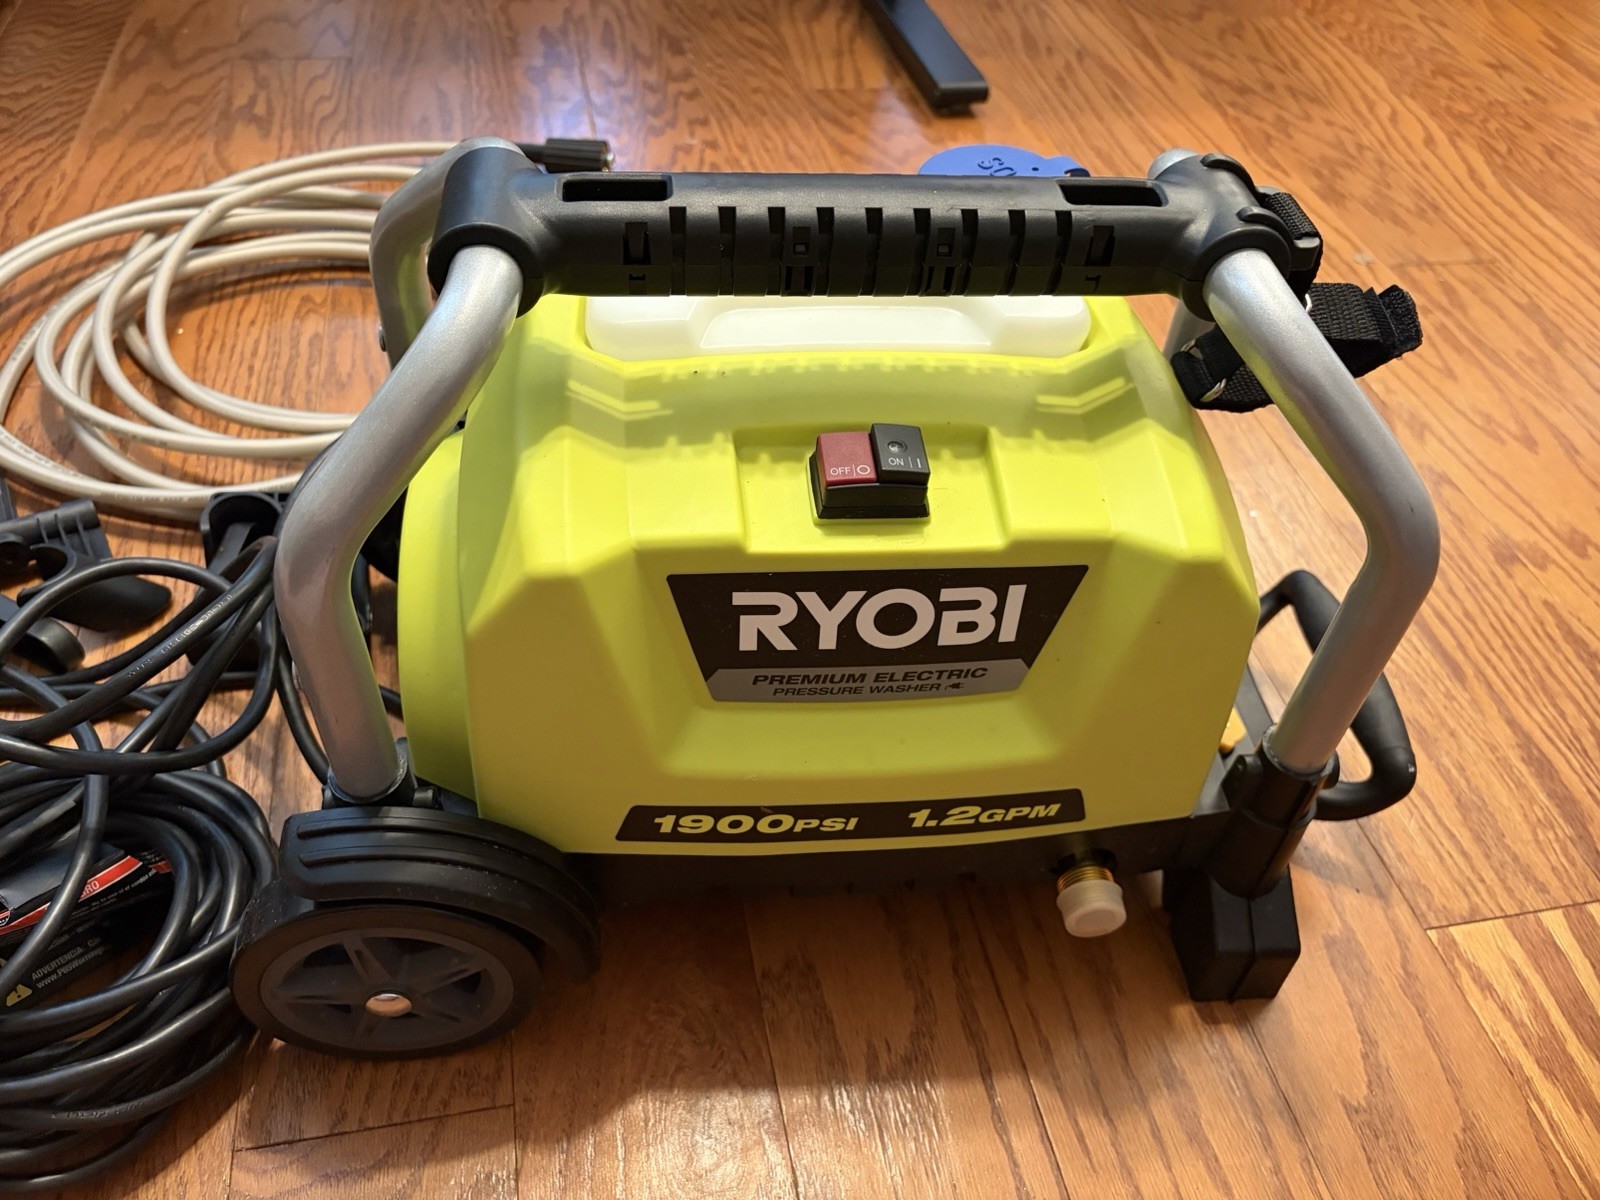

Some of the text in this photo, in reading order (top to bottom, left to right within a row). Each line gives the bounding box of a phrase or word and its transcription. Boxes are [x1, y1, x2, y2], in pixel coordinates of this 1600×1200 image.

[888, 457, 904, 466] ON
[830, 466, 851, 476] OFF
[732, 584, 1027, 651] RYOBI
[752, 667, 988, 686] PREMIUM ELECTRIC
[772, 682, 941, 696] PRESSURE WASHER
[653, 803, 1062, 834] 1900PSI 1.2GPM
